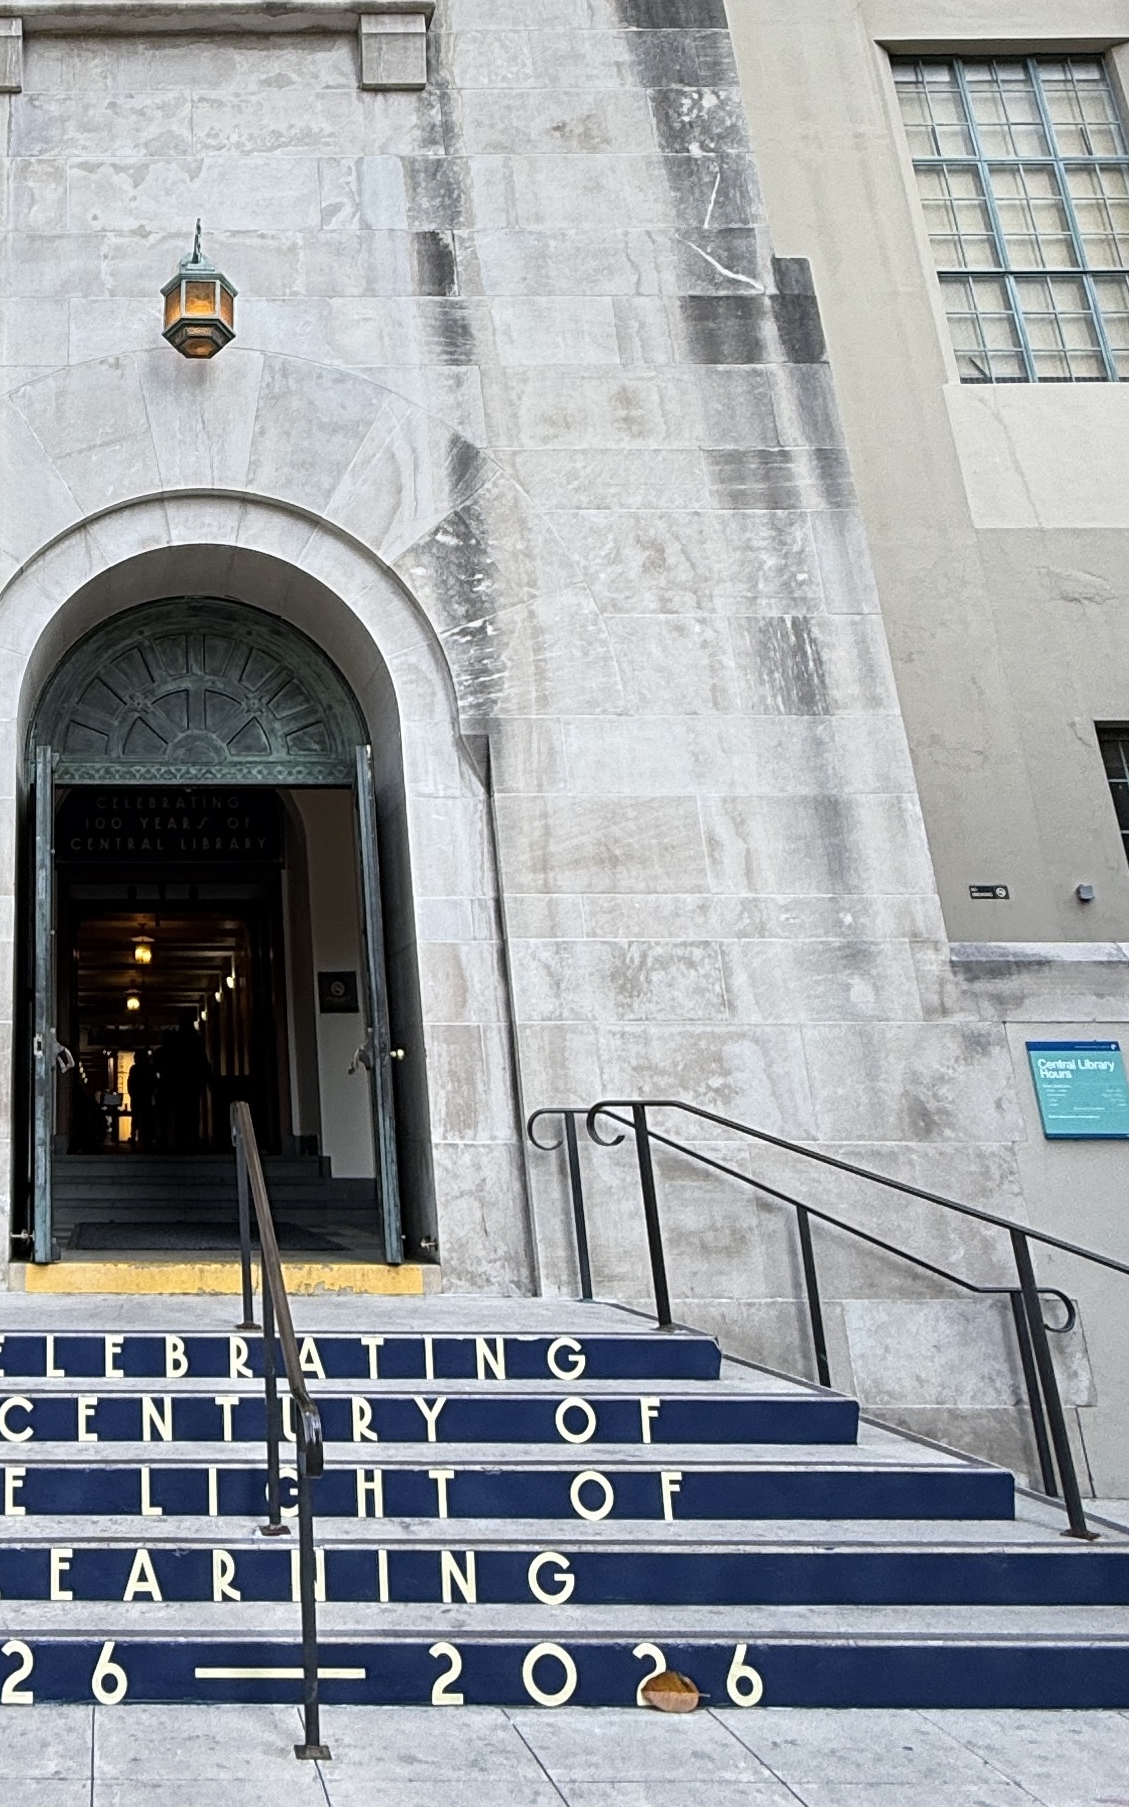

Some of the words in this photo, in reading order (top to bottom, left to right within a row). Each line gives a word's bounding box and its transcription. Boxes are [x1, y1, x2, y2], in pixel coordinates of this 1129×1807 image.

[95, 795, 240, 809] CELEBRATING
[85, 816, 123, 830] 100
[139, 816, 210, 830] YEARS
[226, 816, 252, 830] OF
[70, 837, 165, 851] CENTRAL
[180, 837, 267, 851] LIBRARY
[1037, 1059, 1077, 1070] Central
[1078, 1059, 1115, 1072] Library
[1040, 1069, 1073, 1079] Hours
[555, 1395, 661, 1444] OF
[570, 1469, 682, 1521] OF
[428, 1641, 764, 1708] 2026
